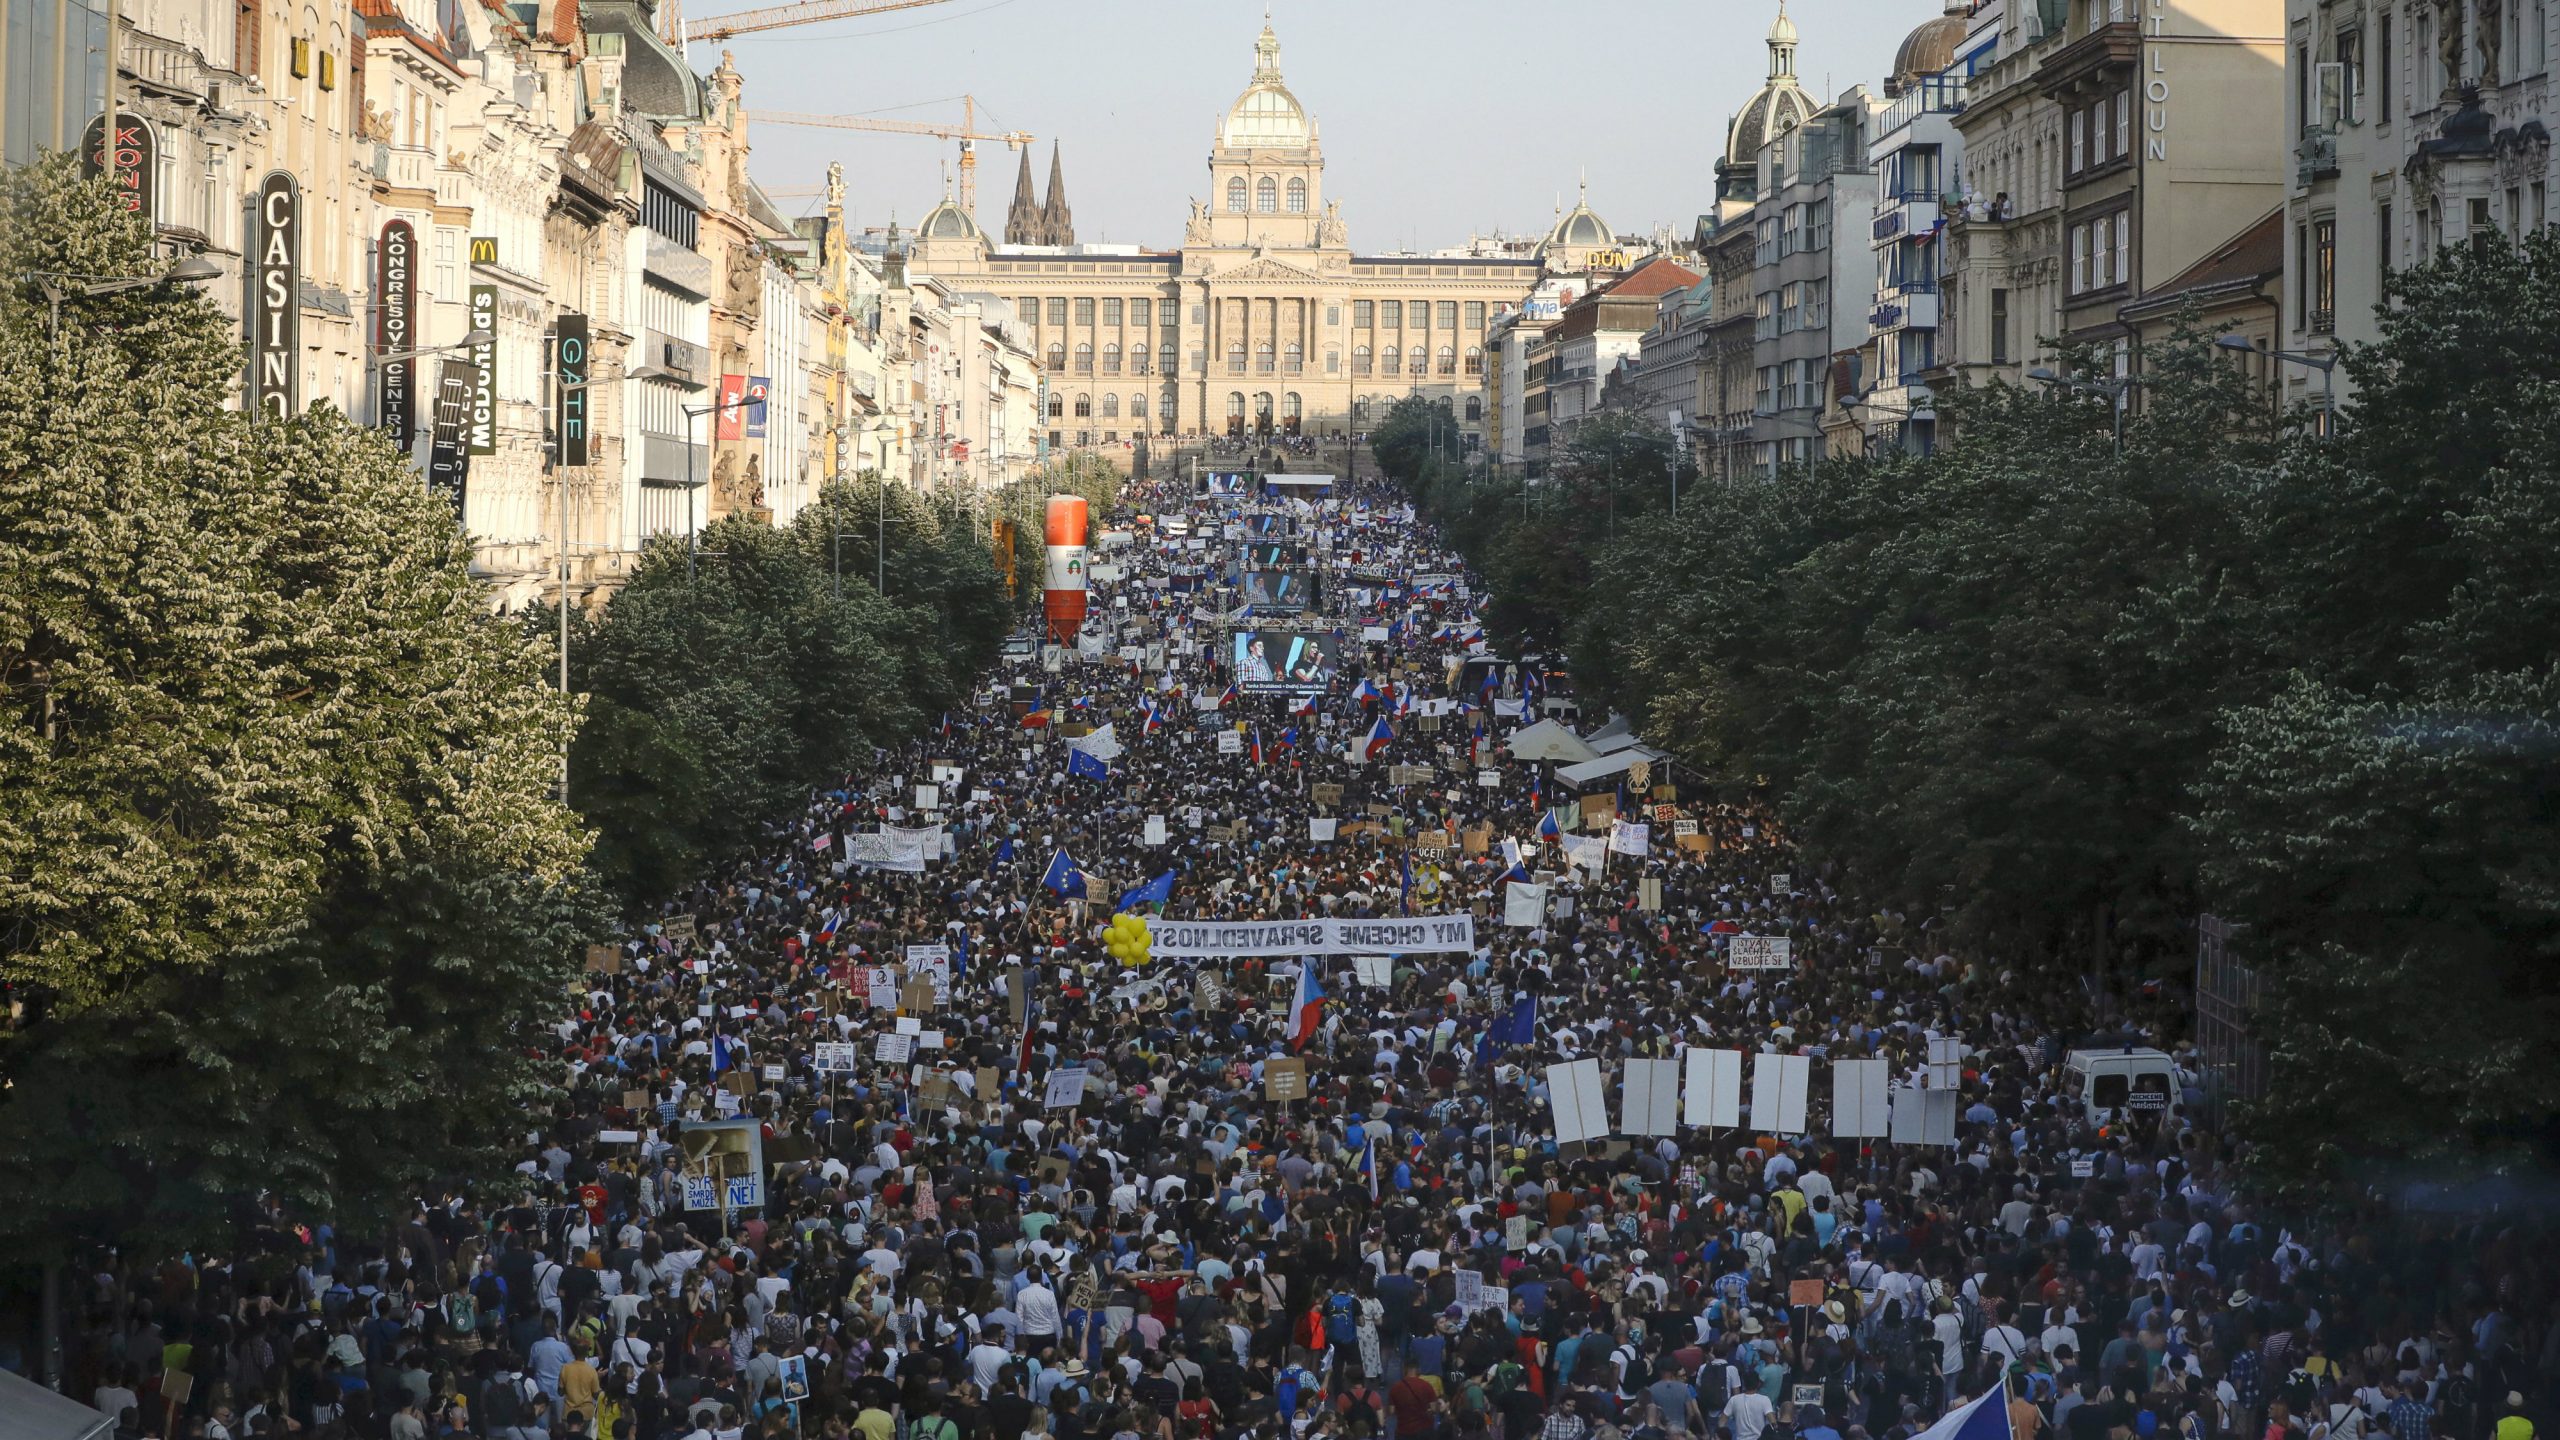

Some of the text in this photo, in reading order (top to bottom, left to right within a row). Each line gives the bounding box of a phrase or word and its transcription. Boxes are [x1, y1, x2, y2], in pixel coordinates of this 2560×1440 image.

[2147, 0, 2168, 160] TLOUN
[471, 292, 492, 448] McDonad's
[1772, 956, 1783, 966] SE
[730, 1186, 754, 1206] NE!
